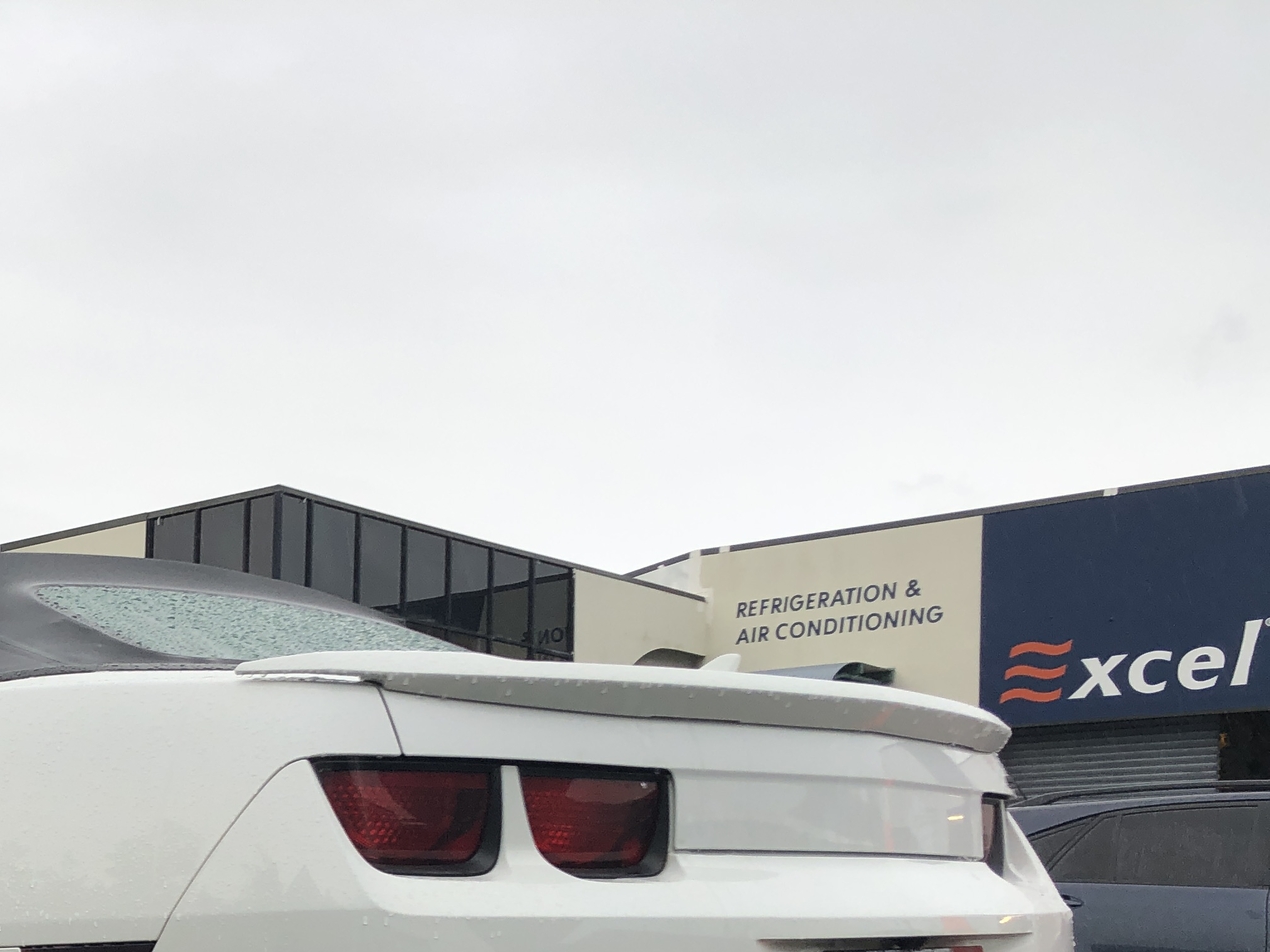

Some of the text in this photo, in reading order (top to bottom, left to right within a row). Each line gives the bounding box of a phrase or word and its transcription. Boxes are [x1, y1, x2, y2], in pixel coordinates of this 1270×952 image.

[736, 578, 922, 619] REFRIGERATION &
[735, 604, 944, 646] AIR CONDITIONING
